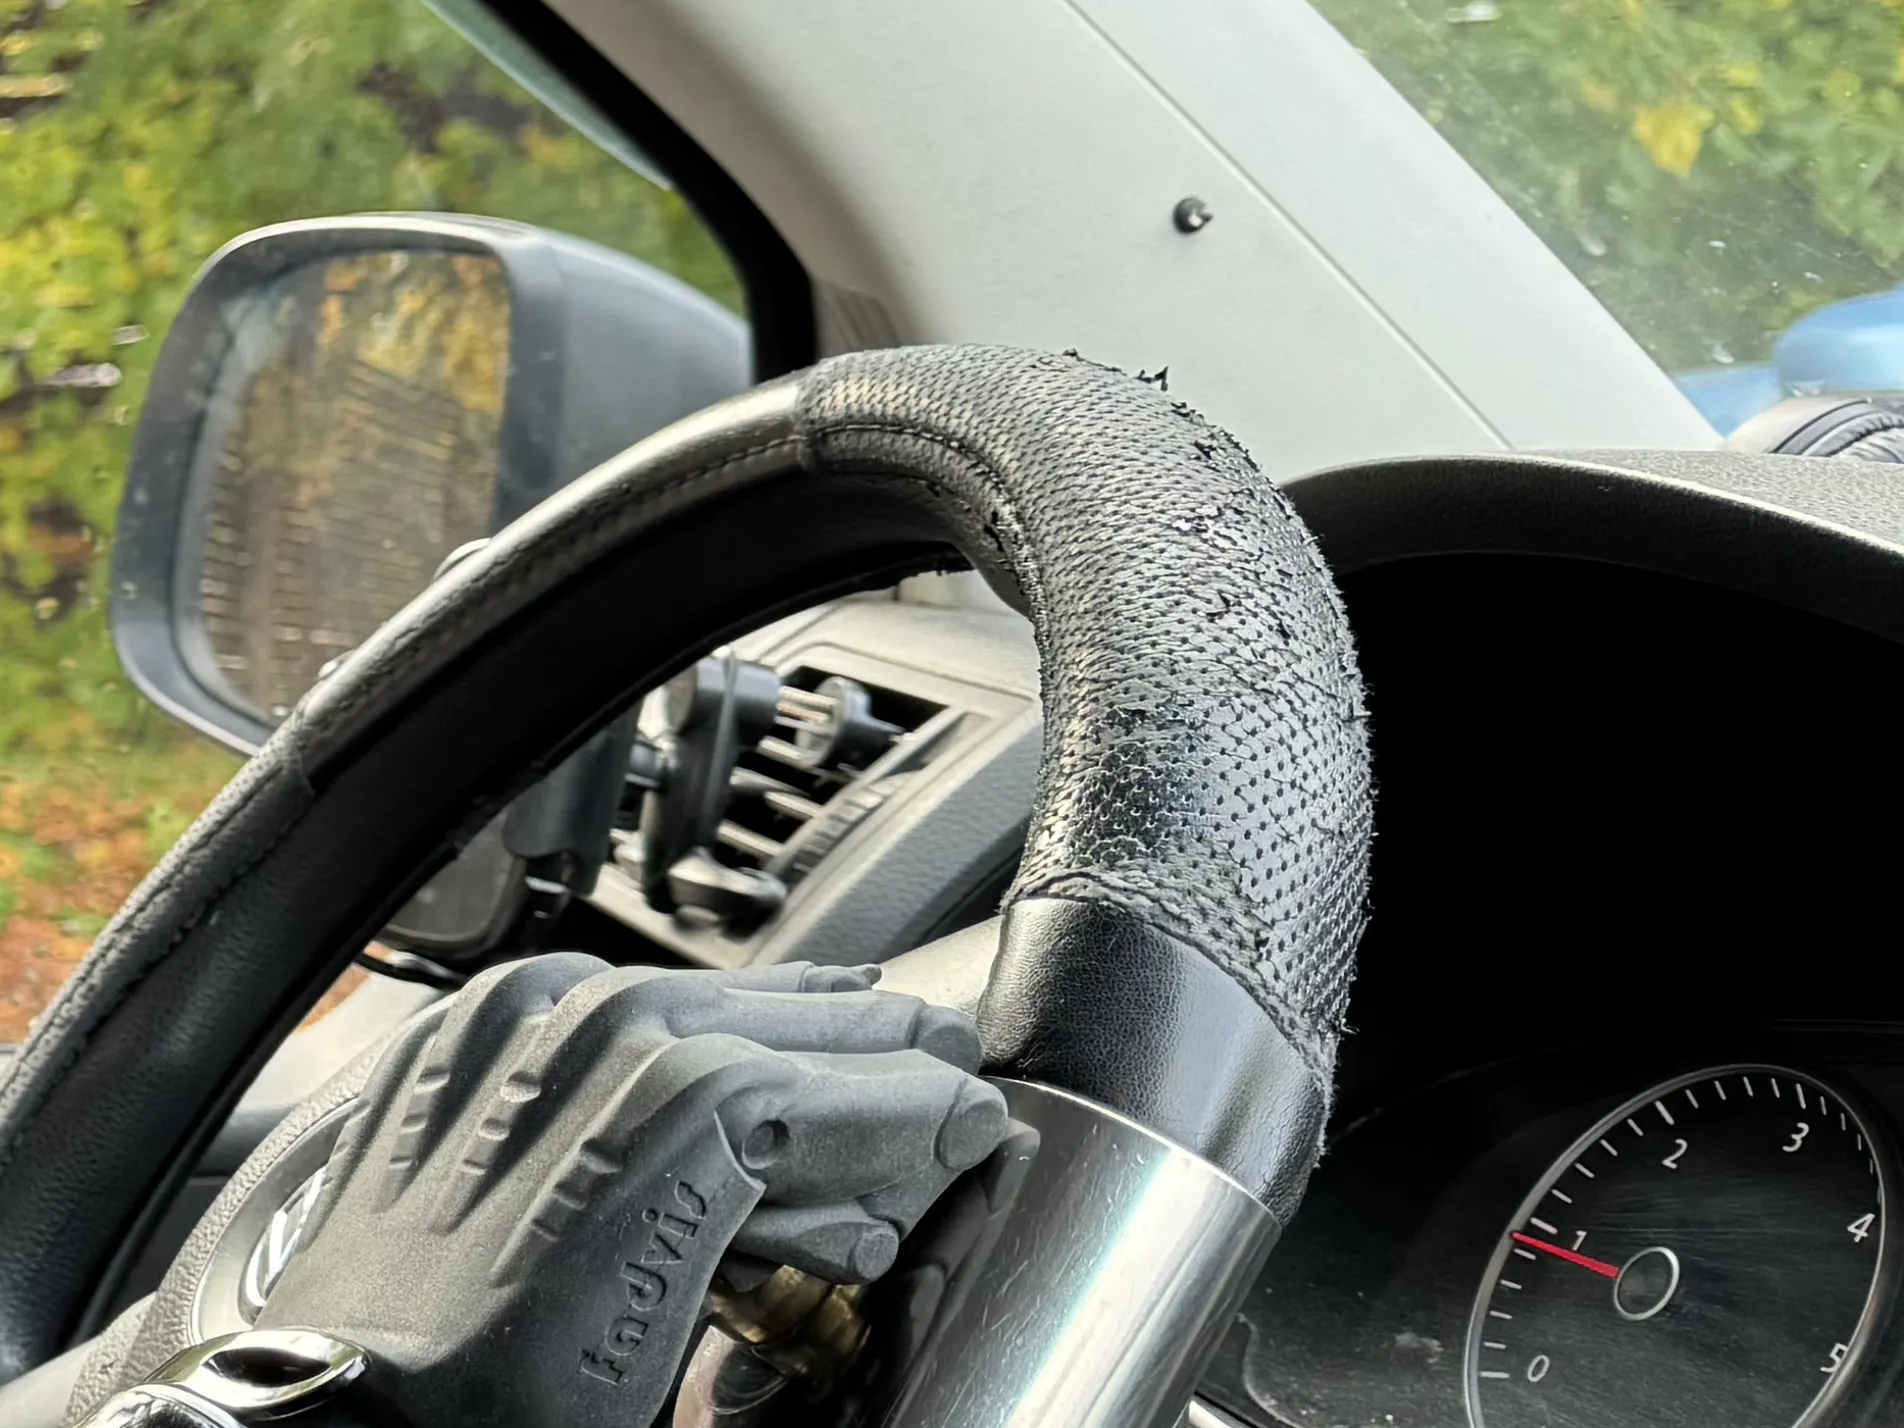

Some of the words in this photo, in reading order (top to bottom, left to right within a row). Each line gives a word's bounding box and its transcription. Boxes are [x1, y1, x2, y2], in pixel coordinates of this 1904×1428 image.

[1782, 1122, 1810, 1152] 3
[1661, 1138, 1688, 1169] 2
[1572, 1230, 1587, 1251] 1
[1847, 1213, 1875, 1242] 4
[1526, 1355, 1550, 1382] 0
[1820, 1343, 1848, 1373] 5
